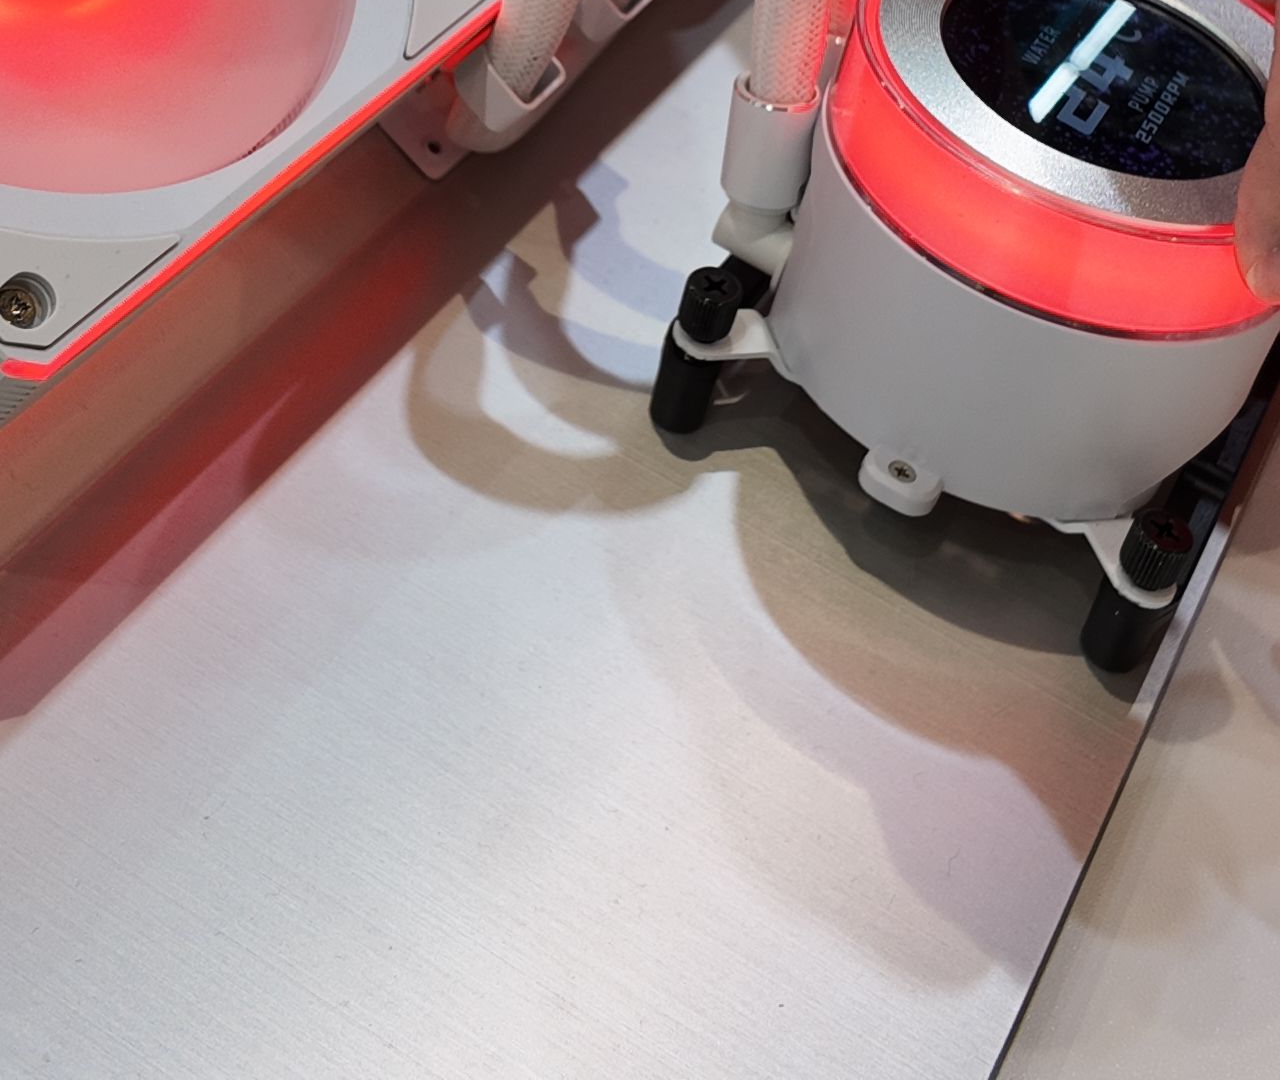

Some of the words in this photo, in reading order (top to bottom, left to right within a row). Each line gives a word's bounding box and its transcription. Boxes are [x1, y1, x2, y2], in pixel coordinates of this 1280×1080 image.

[1022, 25, 1061, 65] WATER
[1128, 76, 1159, 113] PUMP
[1135, 70, 1189, 144] 2500RPM
